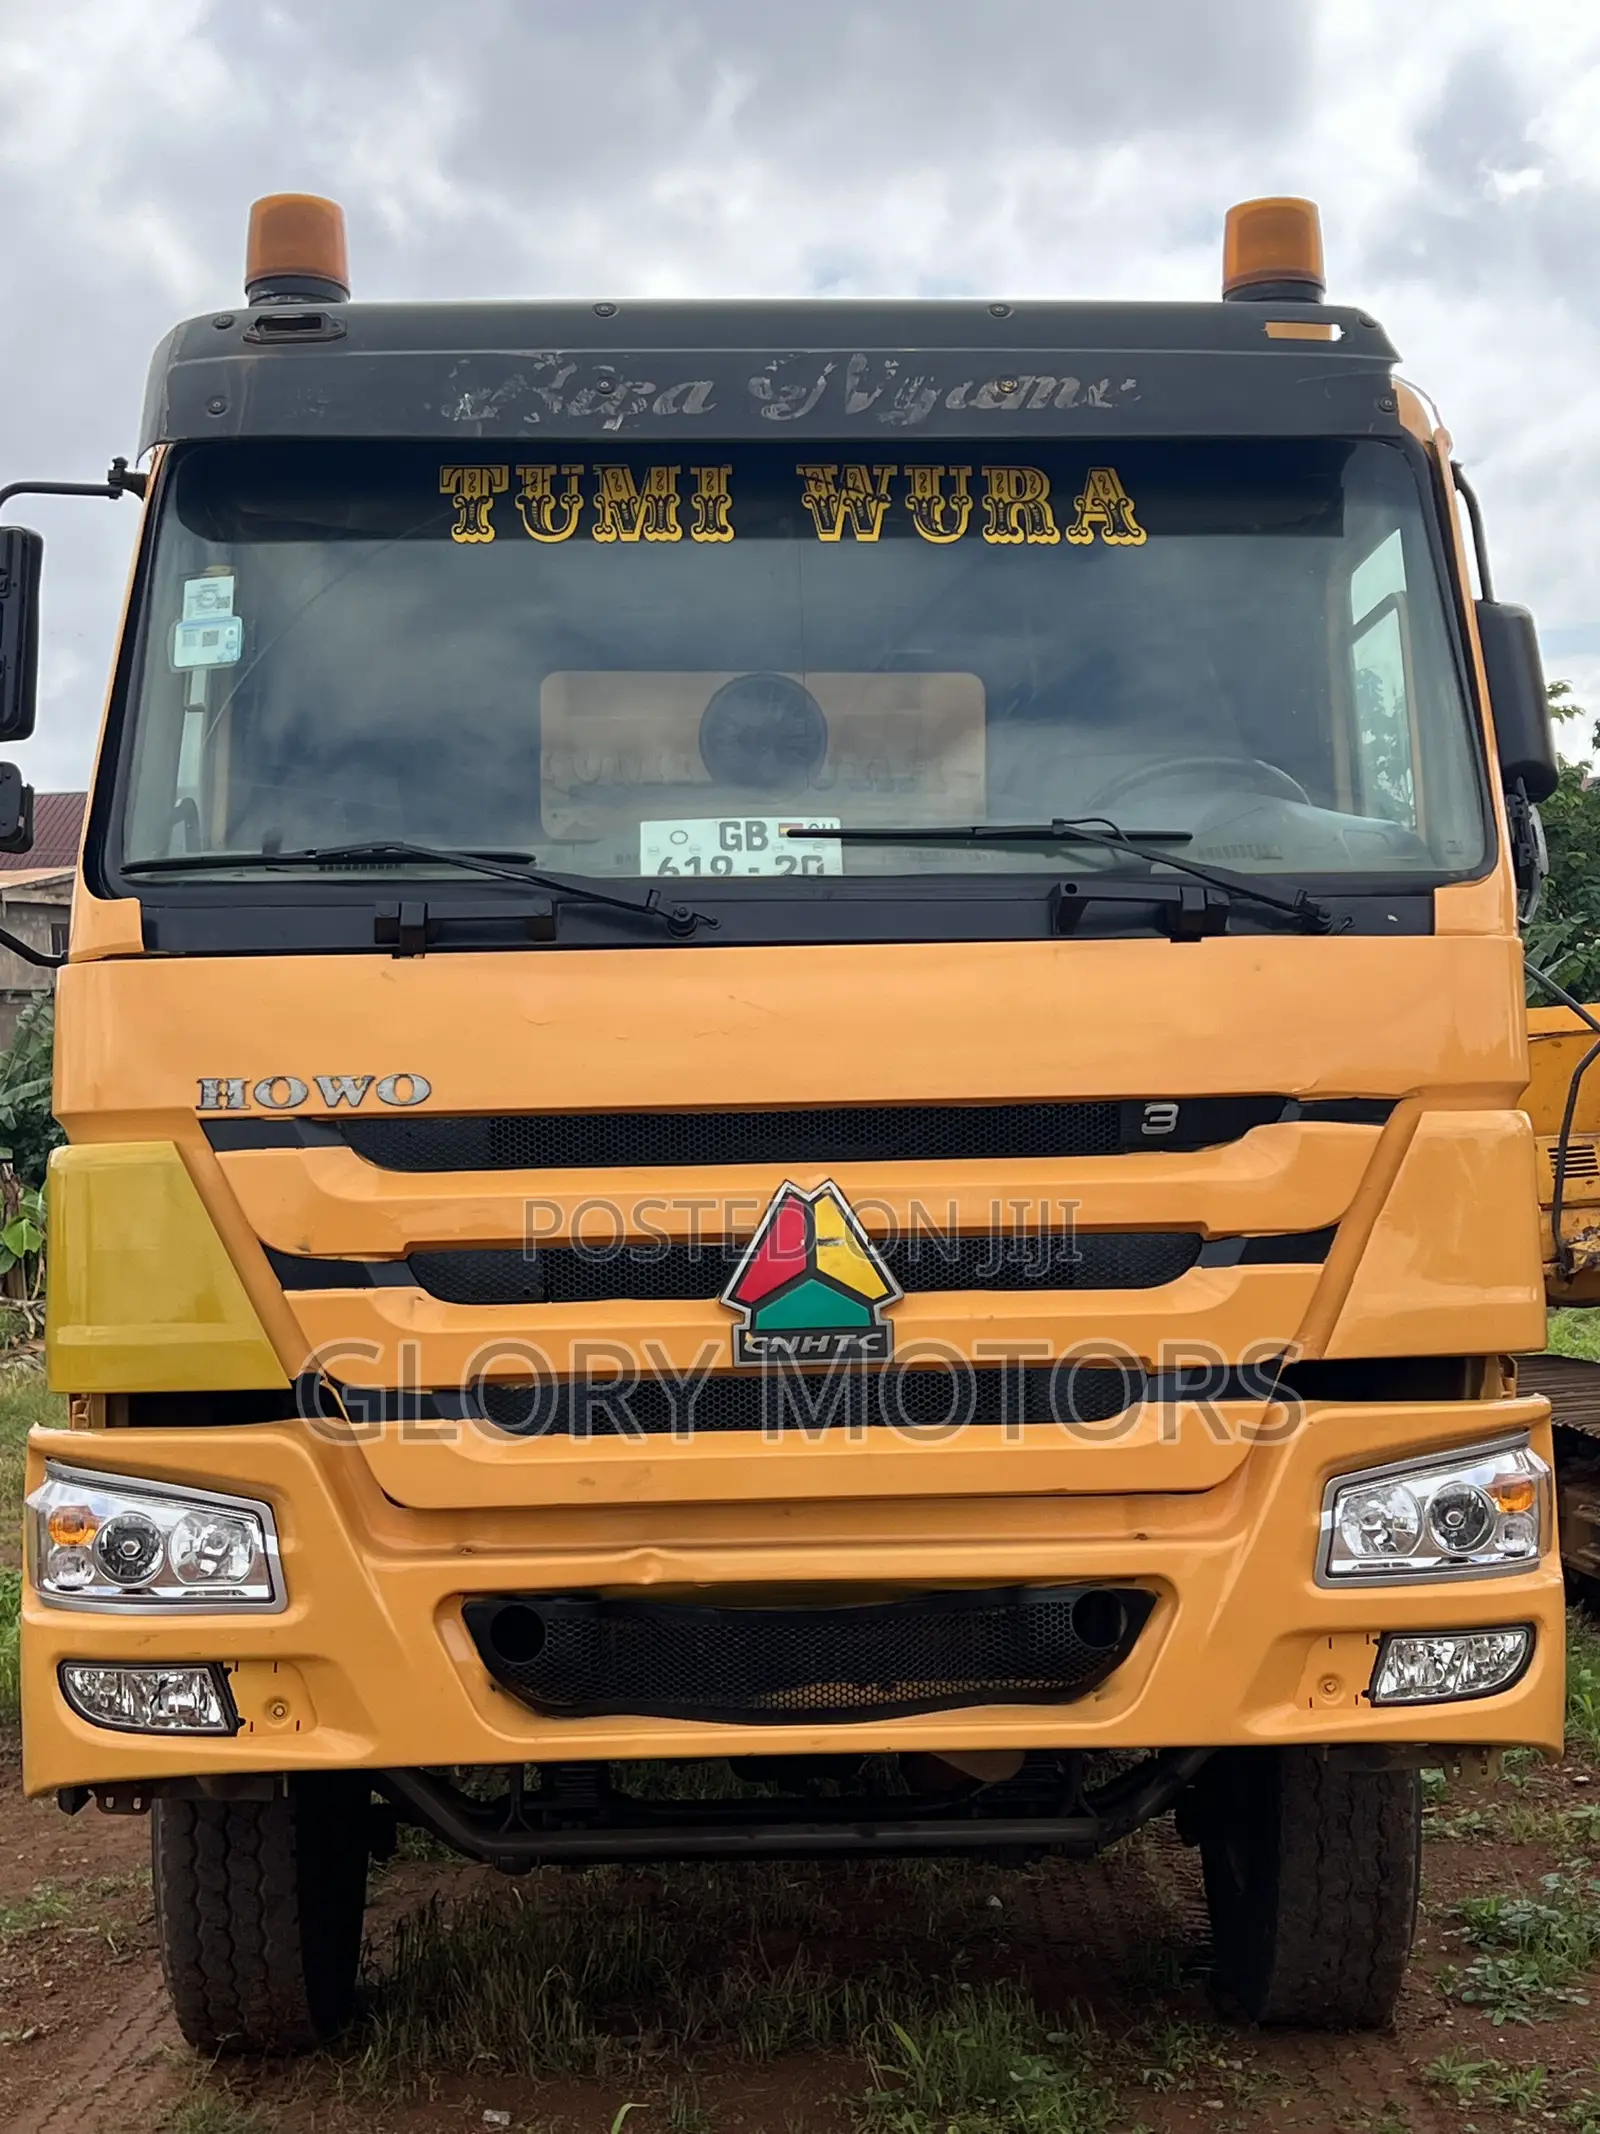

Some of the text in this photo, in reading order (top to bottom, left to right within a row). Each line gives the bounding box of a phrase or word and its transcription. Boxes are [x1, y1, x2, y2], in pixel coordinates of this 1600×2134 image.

[439, 463, 1149, 546] TUMI WURA
[719, 820, 769, 852] GB
[196, 1073, 432, 1110] HOWO
[1141, 1103, 1180, 1135] 3
[744, 1333, 883, 1354] CNHTC
